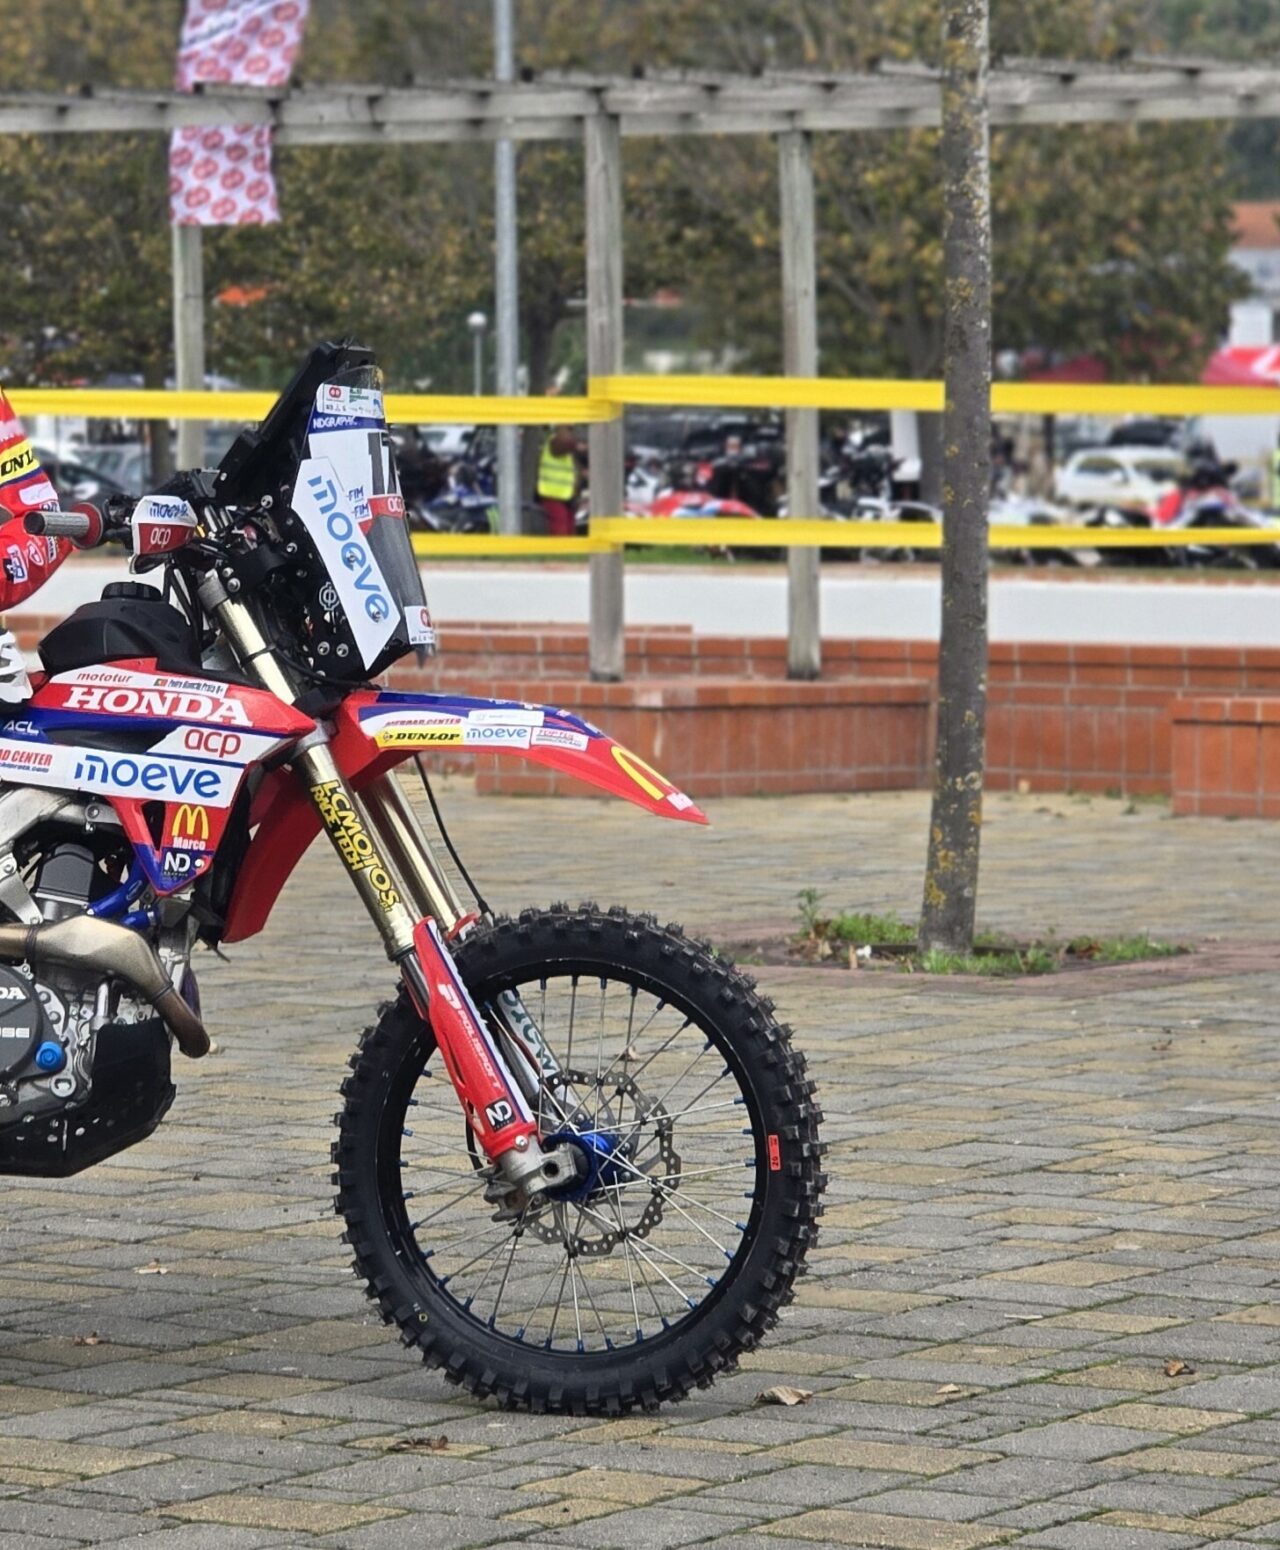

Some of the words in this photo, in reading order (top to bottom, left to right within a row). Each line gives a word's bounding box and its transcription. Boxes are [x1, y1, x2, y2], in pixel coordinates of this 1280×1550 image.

[347, 485, 364, 501] FIM
[150, 527, 171, 548] acp
[307, 475, 390, 624] moeve
[76, 672, 134, 684] mototur
[62, 686, 253, 728] HONDA
[3, 721, 40, 734] ACL
[395, 732, 460, 741] DUNLOP
[466, 727, 527, 740] moeve
[184, 728, 241, 758] acp
[11, 750, 53, 767] CENTER
[74, 754, 222, 799] moeve
[172, 836, 206, 851] Marco
[322, 779, 402, 907] LCMOTOS
[334, 826, 366, 871] TECH
